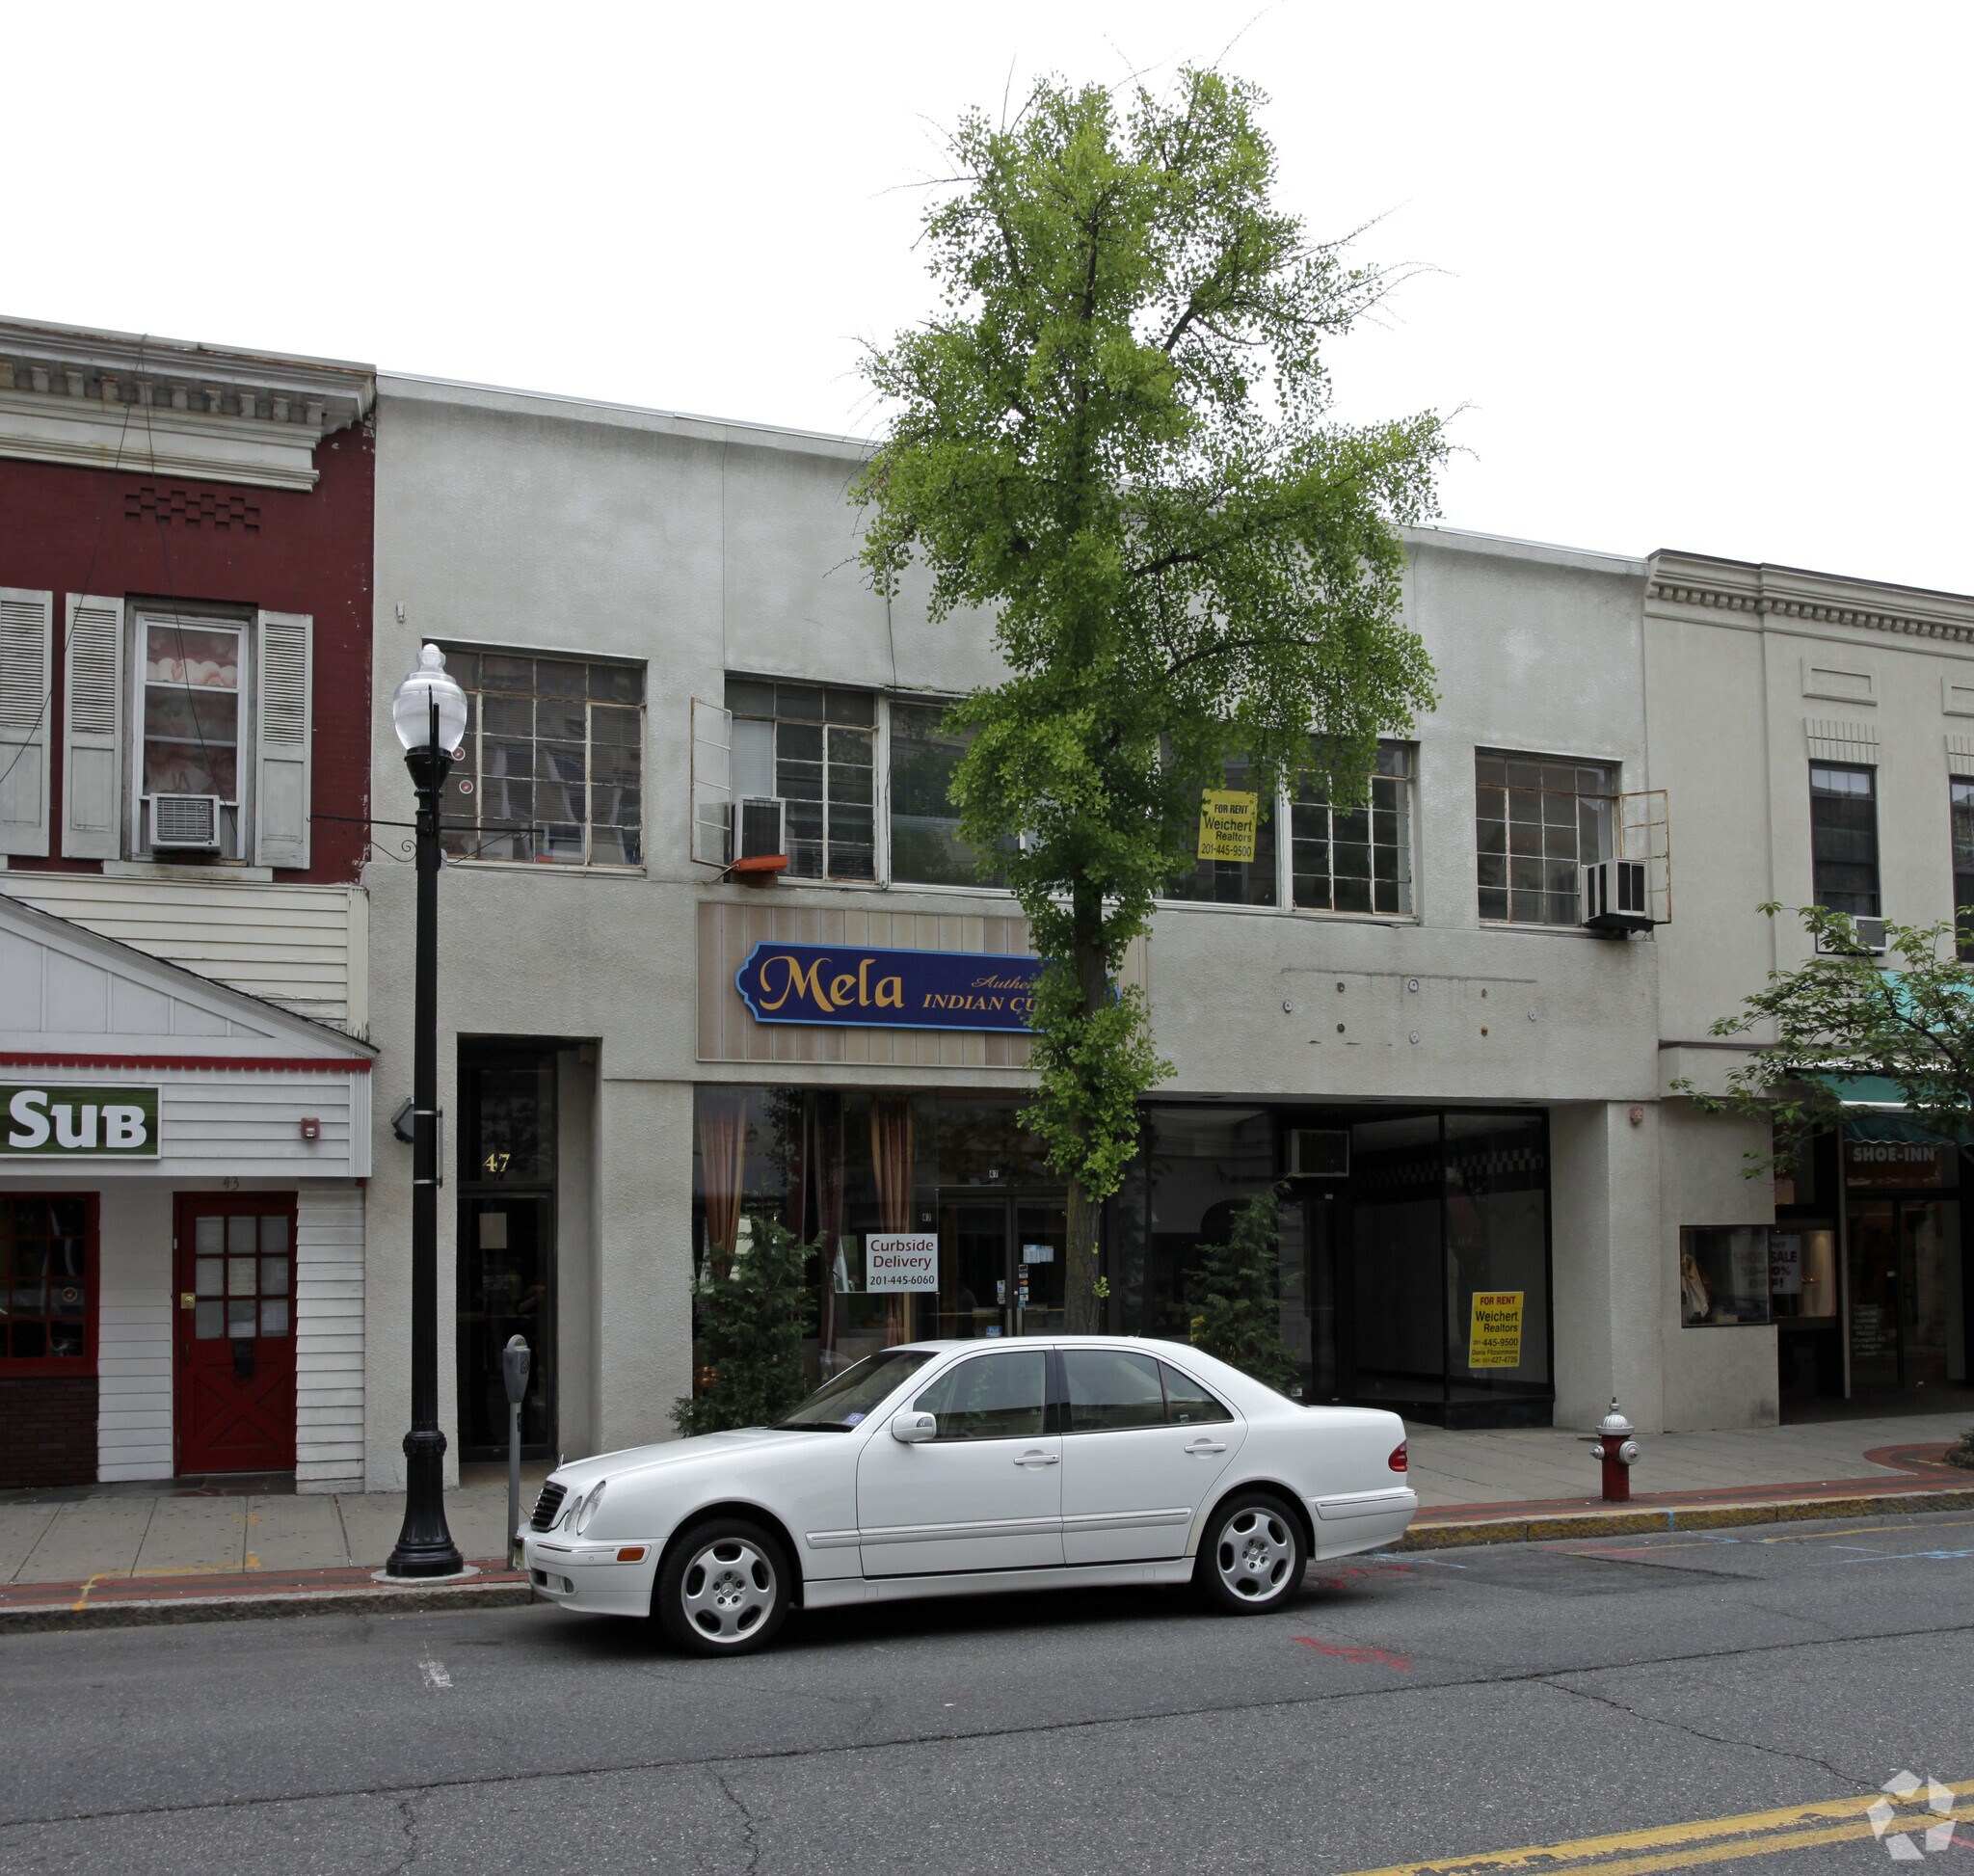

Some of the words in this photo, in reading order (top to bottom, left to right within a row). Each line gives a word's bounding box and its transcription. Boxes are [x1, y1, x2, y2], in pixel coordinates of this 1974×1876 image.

[1214, 804, 1229, 814] FOR
[1230, 805, 1249, 815] RENT
[1204, 816, 1252, 832] Weichert
[1215, 830, 1252, 843] Realtors
[1201, 844, 1252, 857] 201-445-9500
[759, 955, 905, 1012] Mela
[921, 993, 1005, 1011] INDIAN
[1853, 1146, 1935, 1163] SHOE-INN
[482, 1153, 511, 1172] 47
[222, 1176, 240, 1191] 43
[870, 1239, 934, 1252] Curbside
[873, 1255, 932, 1271] Delivery
[1771, 1250, 1798, 1264] SALE
[869, 1274, 935, 1285] 201-445-6060
[1480, 1297, 1494, 1305] FOR
[1496, 1296, 1516, 1305] RENT
[1476, 1311, 1519, 1323] Weichert
[1483, 1323, 1518, 1332] Realtors
